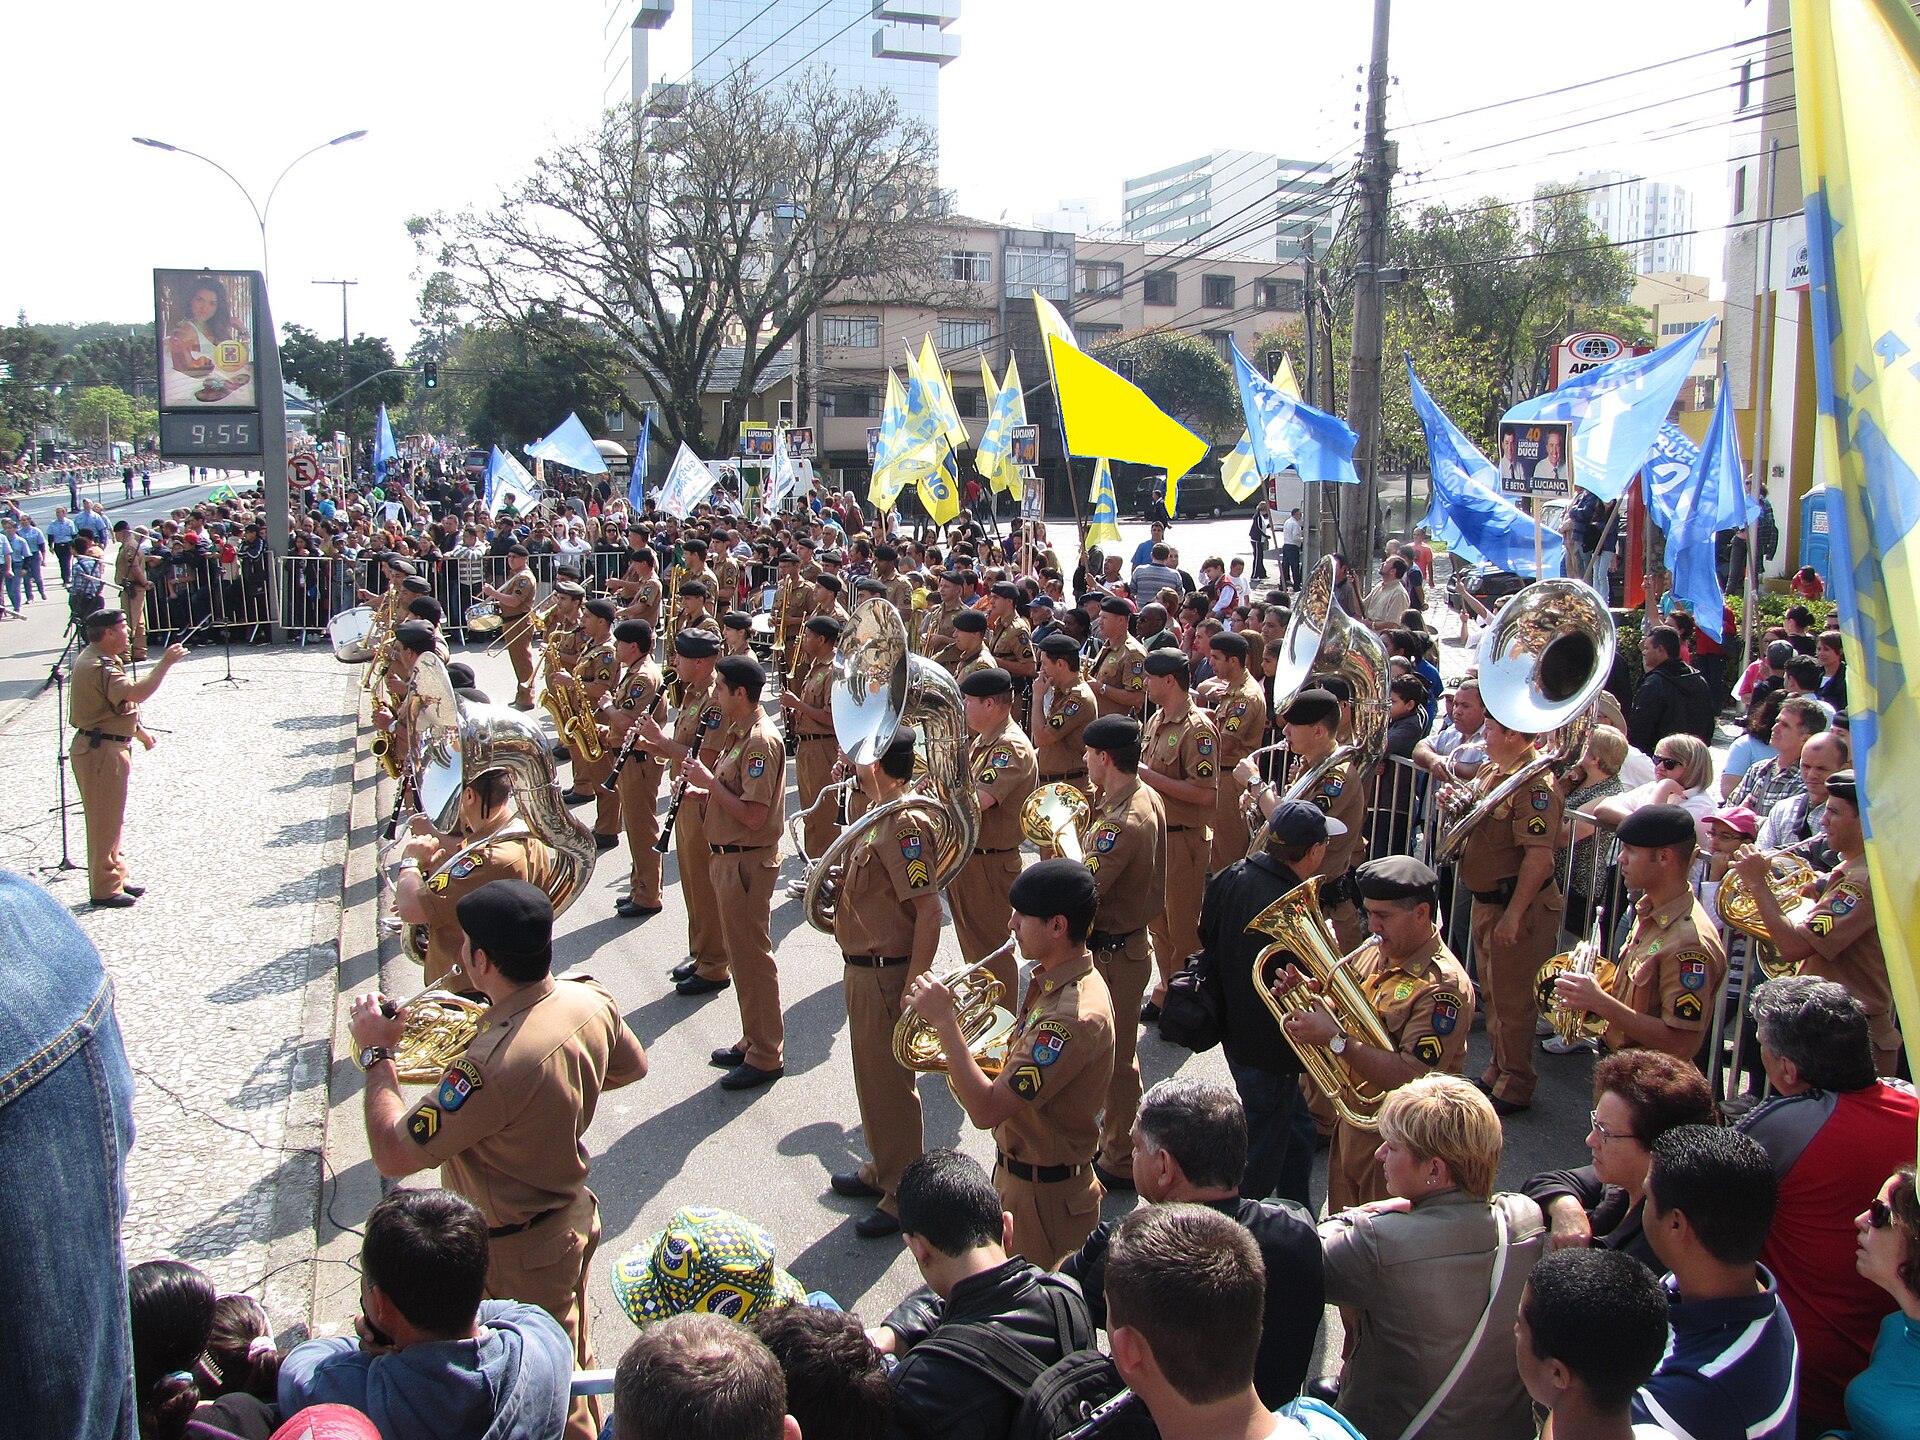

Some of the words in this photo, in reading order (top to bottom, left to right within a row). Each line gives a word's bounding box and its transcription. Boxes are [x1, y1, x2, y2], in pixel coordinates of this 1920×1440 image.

[192, 424, 249, 444] 9:55
[747, 430, 772, 438] LUCIANO
[1012, 428, 1035, 439] LUCIANO
[1526, 427, 1542, 442] 40
[760, 441, 772, 452] 40
[1024, 444, 1035, 460] 40
[1517, 448, 1538, 457] DUCCI
[1510, 482, 1526, 491] BETO.
[1534, 480, 1567, 491] LUCIANO.
[1041, 1022, 1069, 1039] BANDA
[458, 1061, 480, 1085] BANDA
